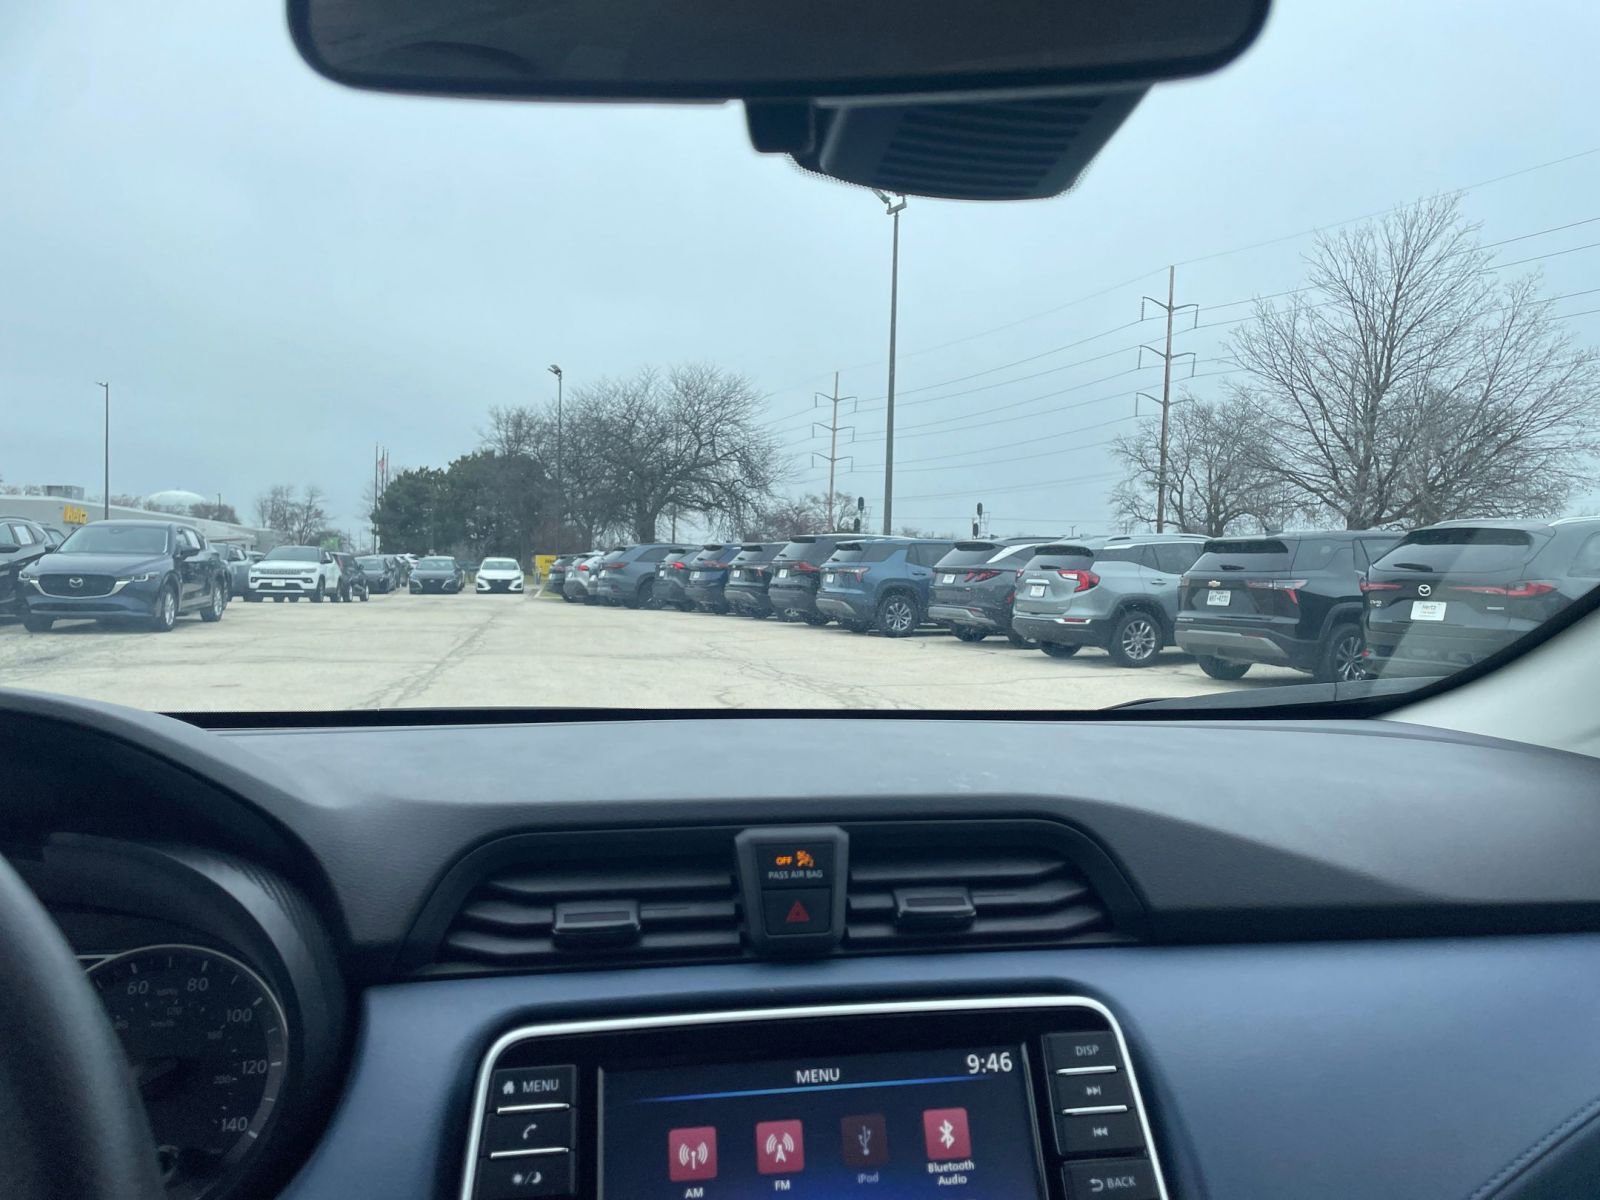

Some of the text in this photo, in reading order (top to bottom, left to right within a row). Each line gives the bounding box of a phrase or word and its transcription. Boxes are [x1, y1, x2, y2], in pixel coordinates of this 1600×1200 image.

[775, 856, 792, 865] OFF
[768, 870, 823, 879] PASS AIR BAG
[127, 980, 149, 996] 60
[186, 977, 209, 992] 80
[226, 1008, 252, 1023] 100
[1075, 1044, 1099, 1057] DISP
[242, 1060, 267, 1075] 120
[966, 1051, 1013, 1075] 9:46
[796, 1067, 840, 1084] MENU
[521, 1078, 560, 1094] MENU
[221, 1116, 249, 1132] 140
[927, 1160, 975, 1173] Bluetooth
[857, 1171, 879, 1184] iPod
[937, 1173, 968, 1186] Audio
[1106, 1175, 1136, 1190] BACK
[684, 1187, 704, 1199] AM
[774, 1179, 791, 1192] FM
